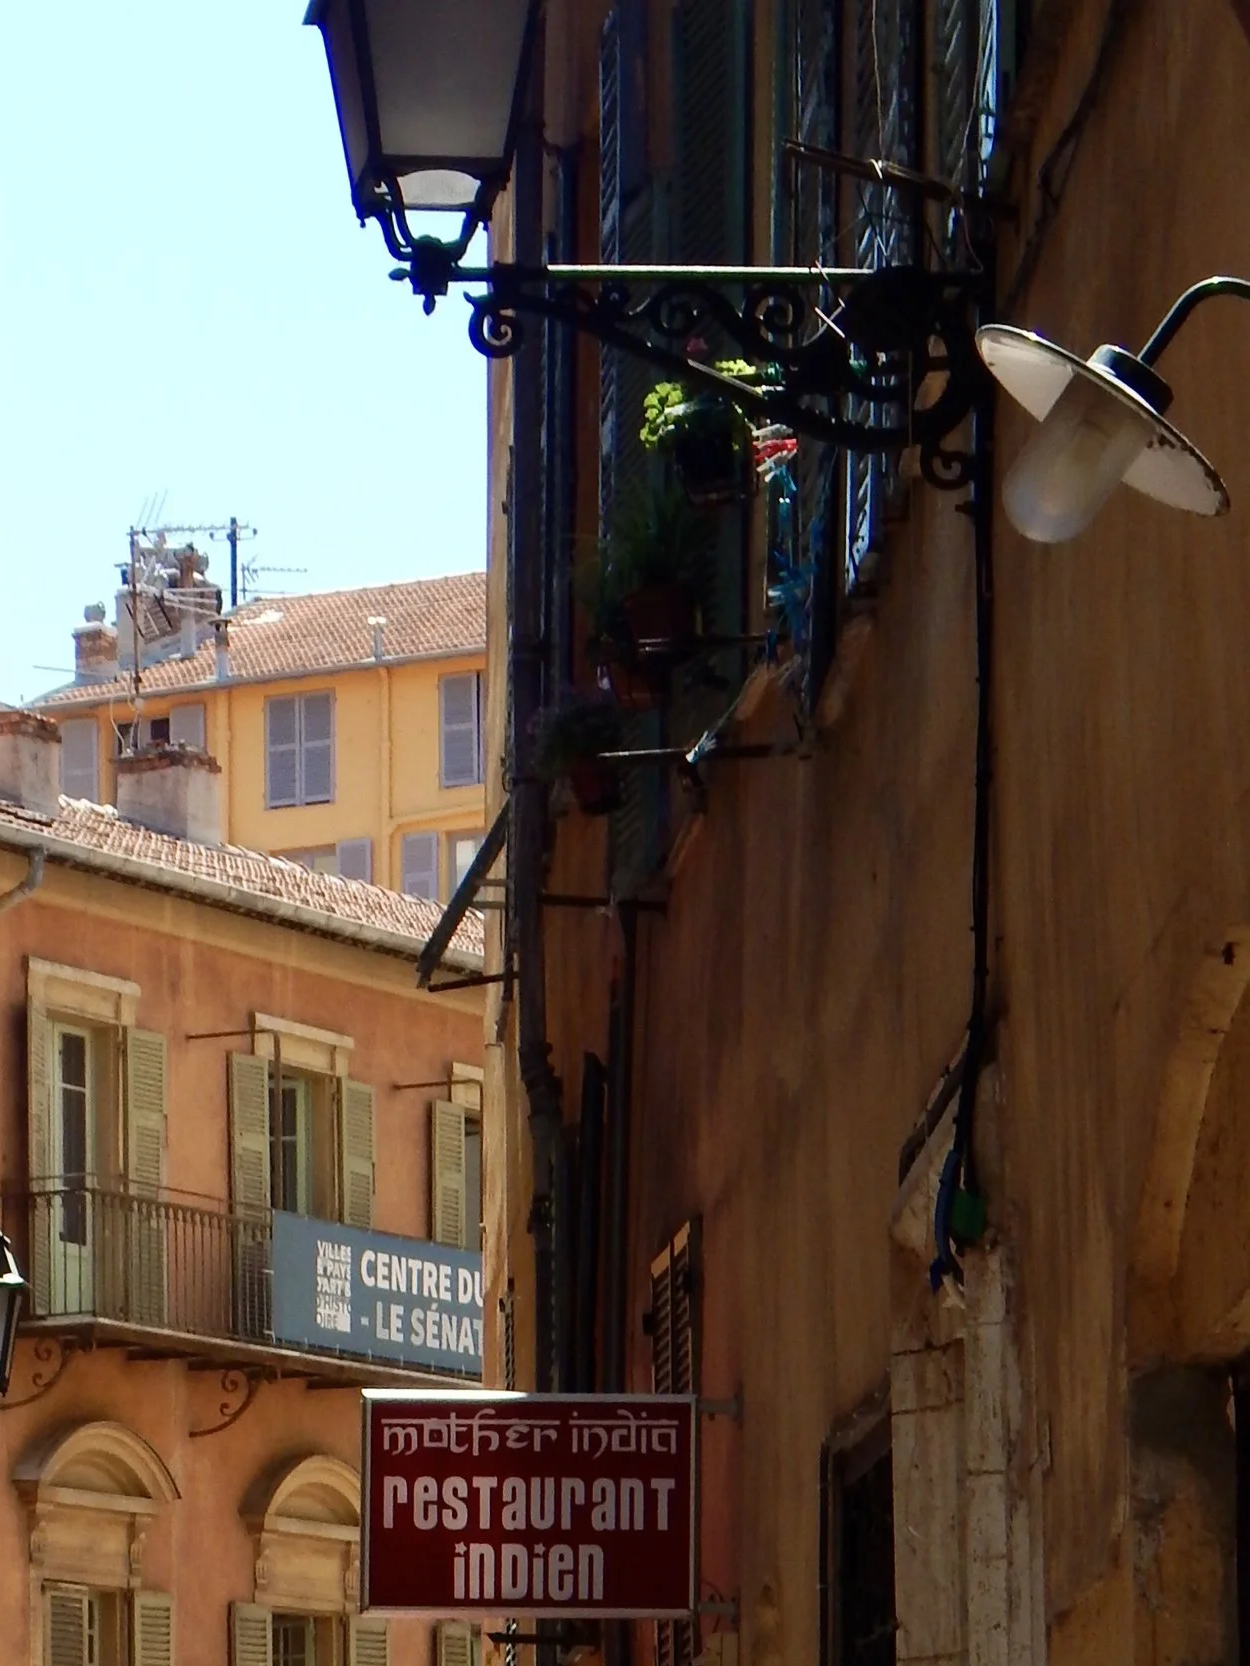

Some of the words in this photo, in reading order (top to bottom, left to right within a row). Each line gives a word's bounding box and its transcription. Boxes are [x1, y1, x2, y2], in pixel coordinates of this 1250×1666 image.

[317, 1240, 351, 1262] VILLES
[361, 1250, 452, 1302] CENTRE
[457, 1268, 484, 1308] DU
[376, 1301, 404, 1343] LE
[568, 1409, 679, 1459] india
